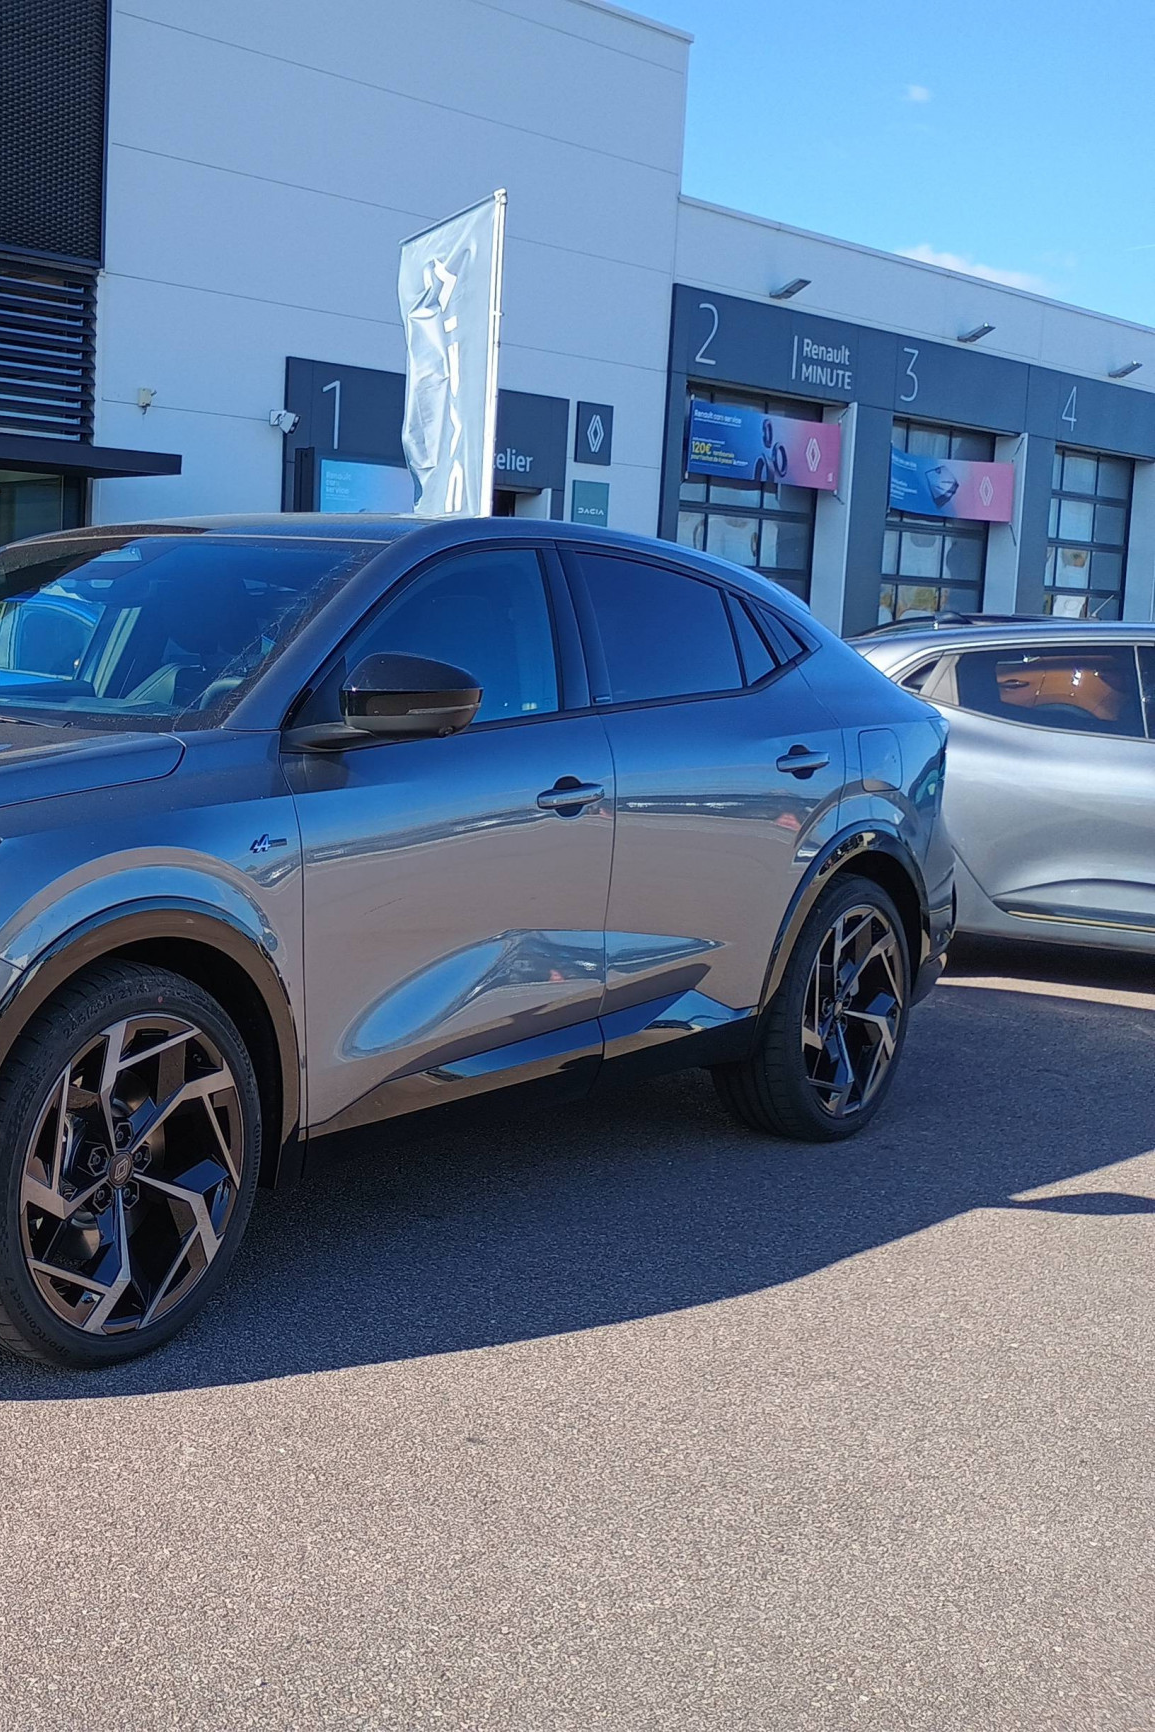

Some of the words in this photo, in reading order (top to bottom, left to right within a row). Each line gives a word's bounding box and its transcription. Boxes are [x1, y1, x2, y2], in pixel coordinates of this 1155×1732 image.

[695, 303, 719, 366] 2
[803, 338, 851, 366] Renault
[801, 363, 853, 390] MINUTE
[900, 347, 919, 402] 3
[322, 380, 341, 450] 1
[1061, 385, 1077, 432] 4
[691, 440, 712, 455] 120€
[577, 507, 604, 516] DACIA
